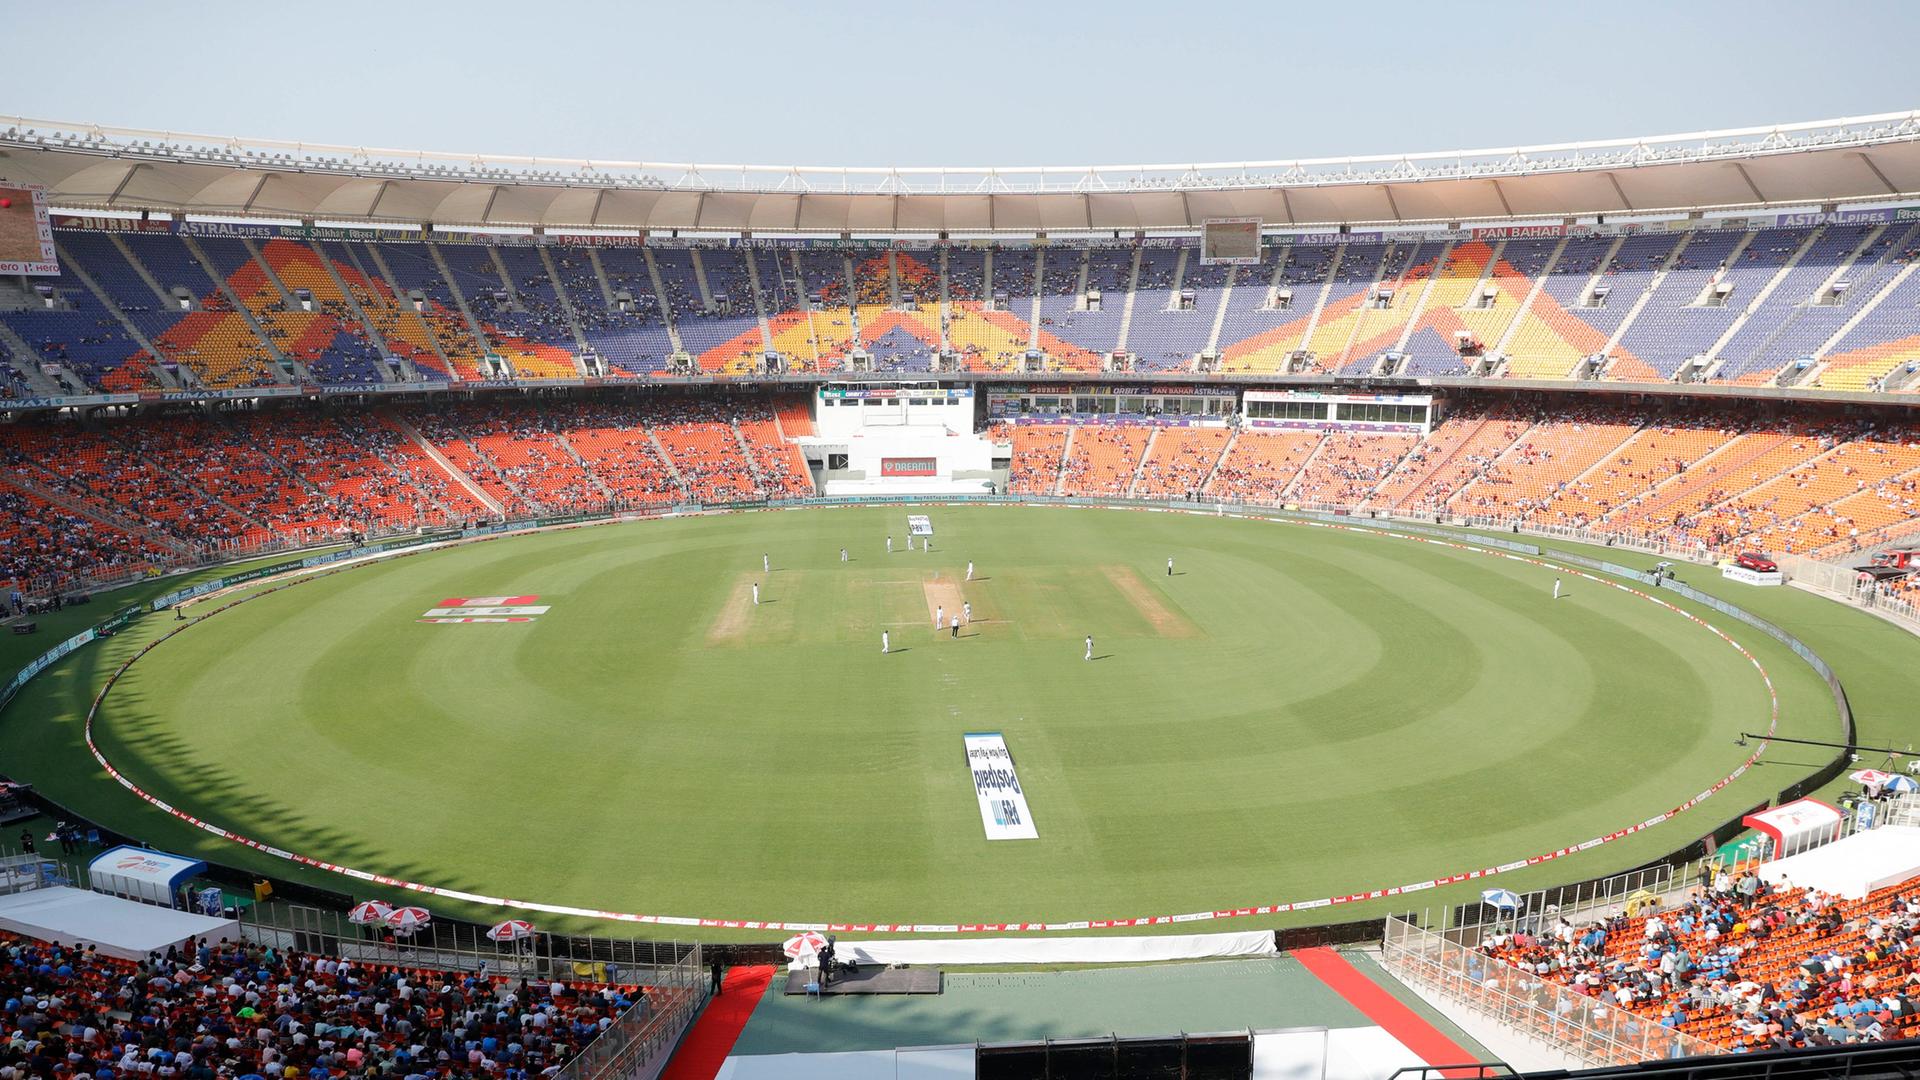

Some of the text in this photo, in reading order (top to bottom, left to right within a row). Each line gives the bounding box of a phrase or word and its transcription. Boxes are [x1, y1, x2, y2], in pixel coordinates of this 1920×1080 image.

[1785, 211, 1886, 226] ASTRAL PIPES
[179, 222, 271, 236] ASTRAL PIPES
[310, 228, 346, 238] Shikhar
[1478, 226, 1561, 238] PAN BAHAR
[564, 235, 593, 246] PAN
[595, 236, 640, 246] BAHAR
[735, 239, 778, 248] ASTRAL
[1141, 238, 1176, 247] ORBIT
[1301, 233, 1377, 244] ASTRAL PIPES
[323, 385, 376, 393] TRIMAX
[467, 380, 516, 388] TRIMAX
[163, 390, 222, 400] TRIMAX
[1113, 387, 1139, 395] ORBIT
[1194, 387, 1221, 395] ASTRAL
[974, 763, 1021, 795] Postpaid
